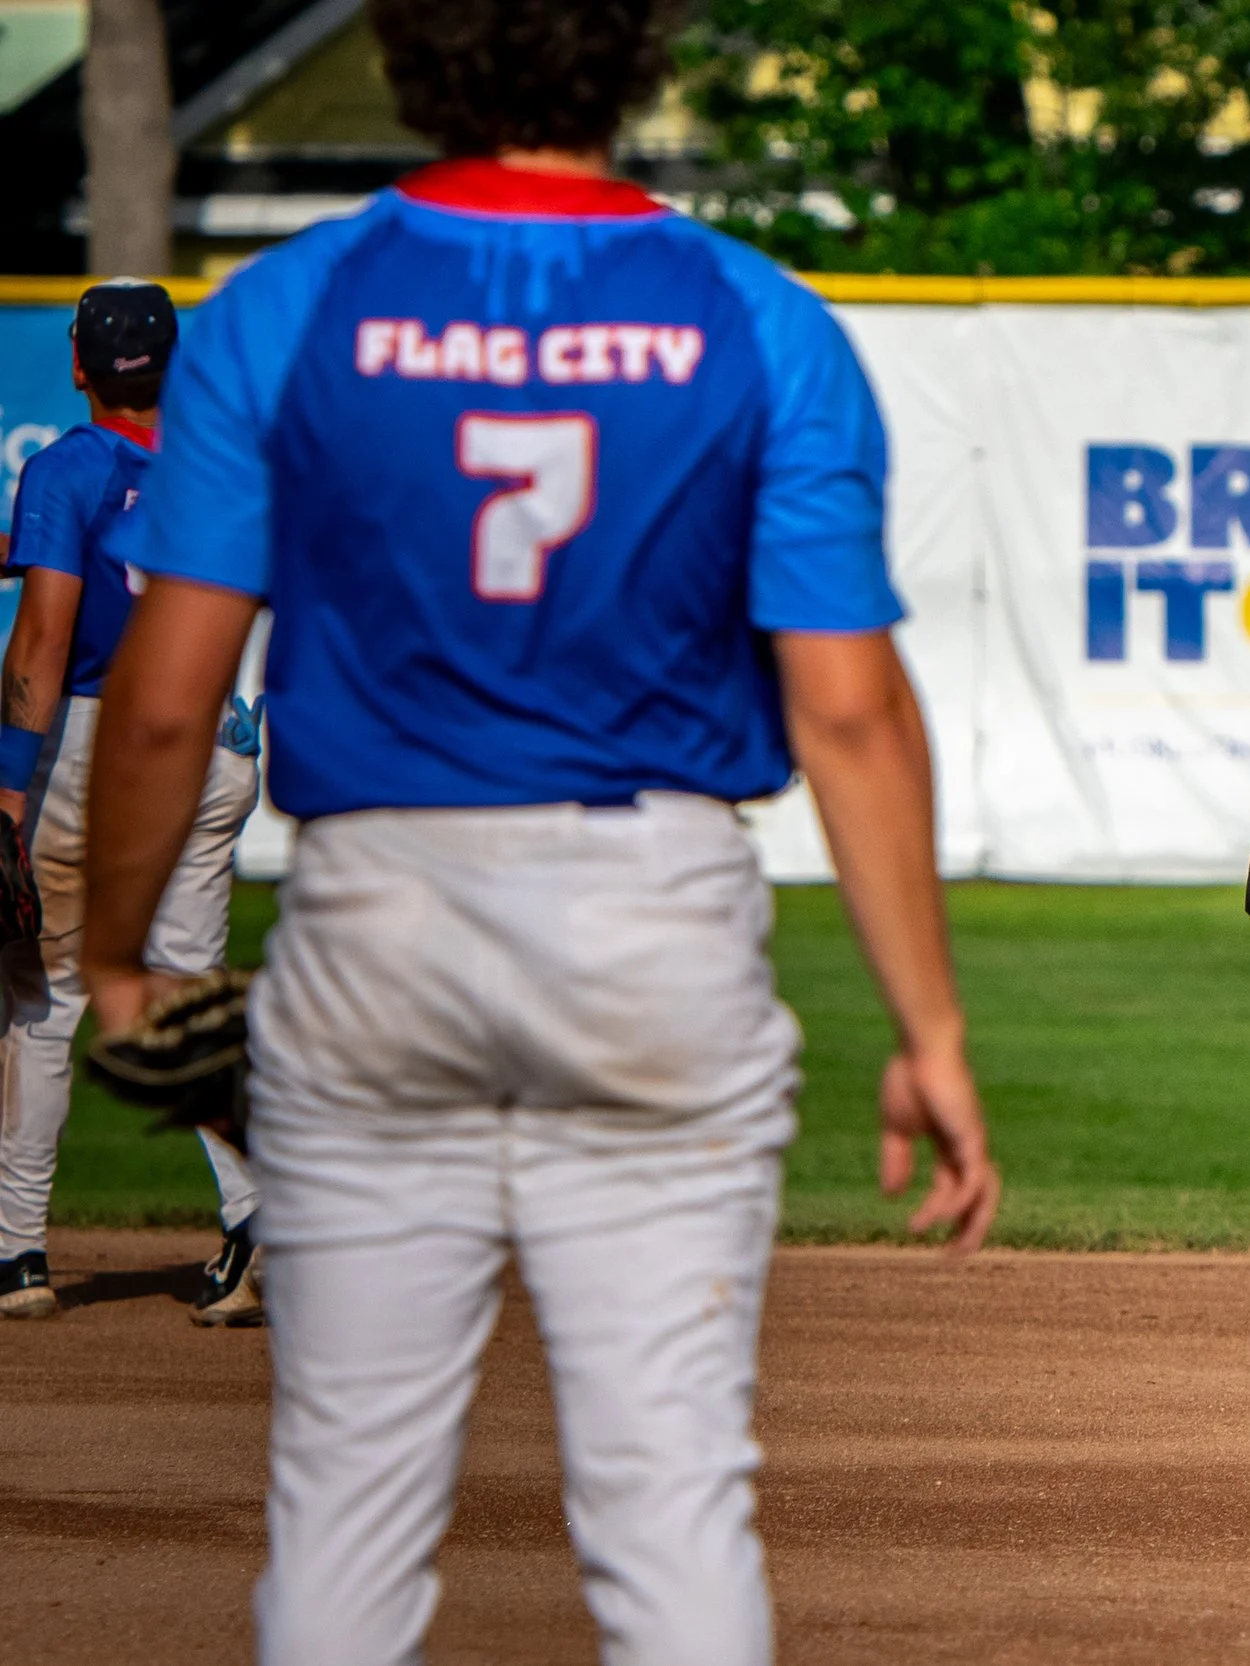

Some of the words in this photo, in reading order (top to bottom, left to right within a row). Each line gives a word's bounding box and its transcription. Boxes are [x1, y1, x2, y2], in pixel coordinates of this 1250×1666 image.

[354, 317, 529, 388] FLAG
[537, 322, 704, 386] CITY
[454, 410, 598, 604] 7
[1084, 558, 1236, 663] IT
